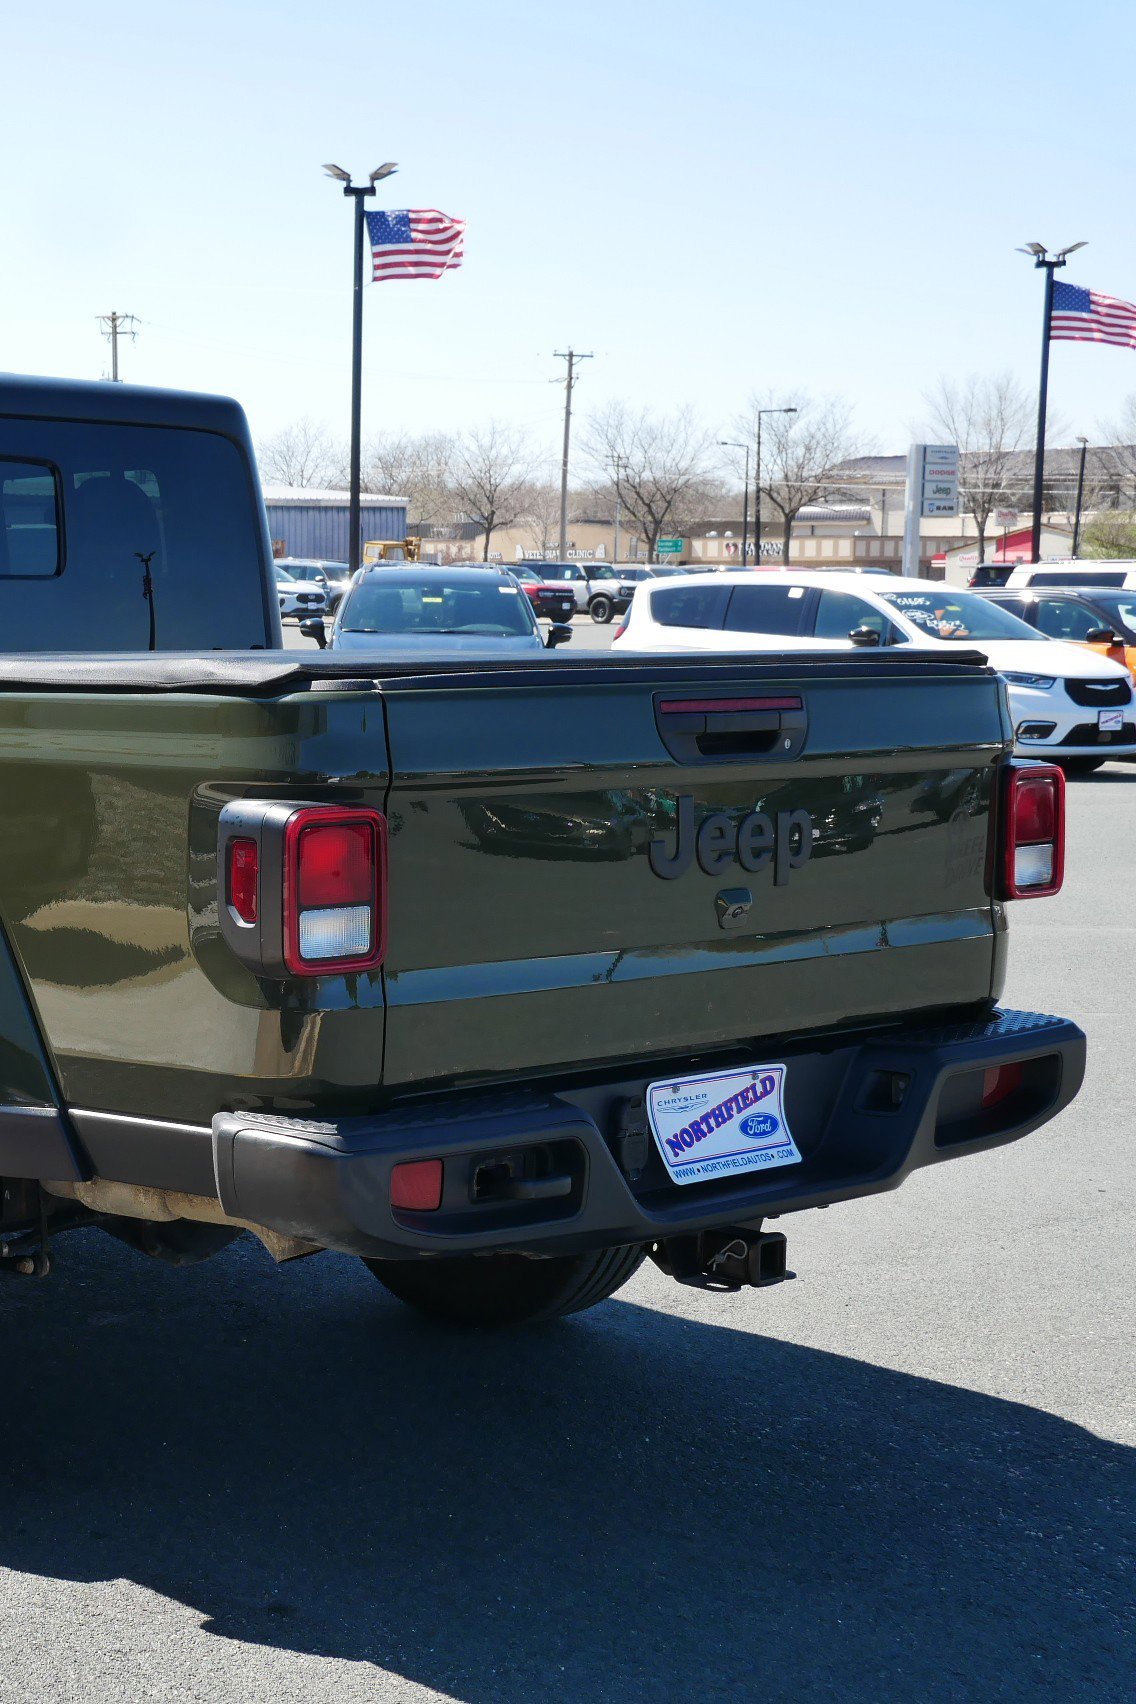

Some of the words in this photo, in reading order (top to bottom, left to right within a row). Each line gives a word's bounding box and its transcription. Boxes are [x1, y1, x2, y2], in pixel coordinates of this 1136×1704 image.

[932, 484, 951, 496] Jeep
[566, 549, 593, 559] CLINIC
[649, 795, 813, 887] Jeep
[657, 1093, 708, 1107] CHRYSLER
[665, 1074, 776, 1158] NORTHFIELD
[747, 1116, 772, 1134] Ford
